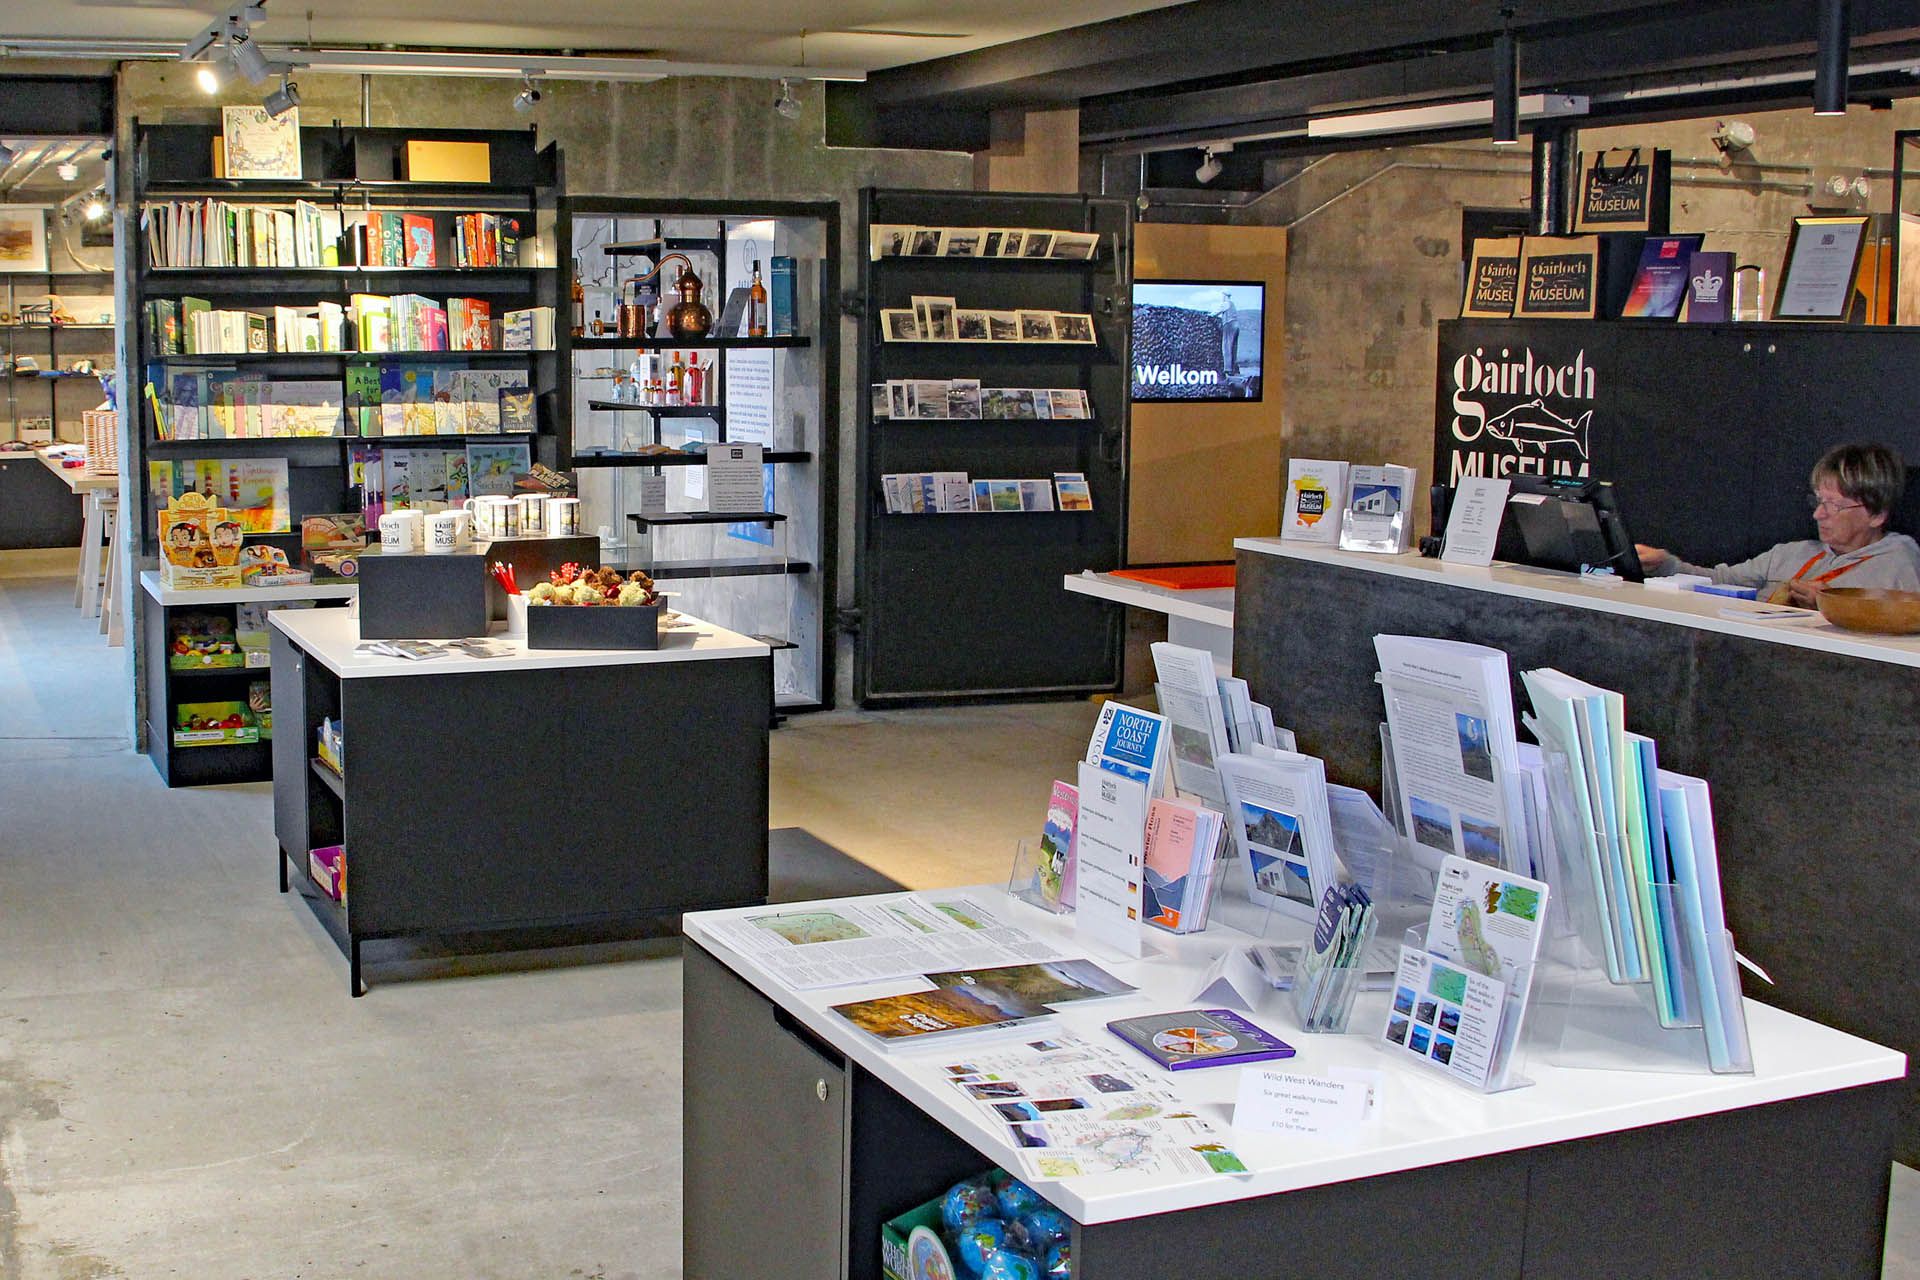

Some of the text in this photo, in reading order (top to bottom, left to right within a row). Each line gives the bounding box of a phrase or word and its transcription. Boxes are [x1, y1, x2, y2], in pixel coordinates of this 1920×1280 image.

[1588, 199, 1640, 212] MUSEUM
[1479, 263, 1517, 289] gairlo
[1531, 261, 1586, 289] gairloch
[1529, 287, 1585, 301] MUSEUM
[1137, 364, 1218, 386] Welkom
[1452, 347, 1595, 442] gairloch
[1119, 713, 1154, 734] NORTH
[1115, 738, 1145, 753] JOURNEY
[1117, 726, 1150, 745] COAST
[1091, 729, 1106, 765] NICO
[1263, 1071, 1345, 1090] Wild West Wanders
[1274, 1090, 1291, 1099] great
[1292, 1093, 1316, 1104] walking
[1318, 1097, 1338, 1105] routes
